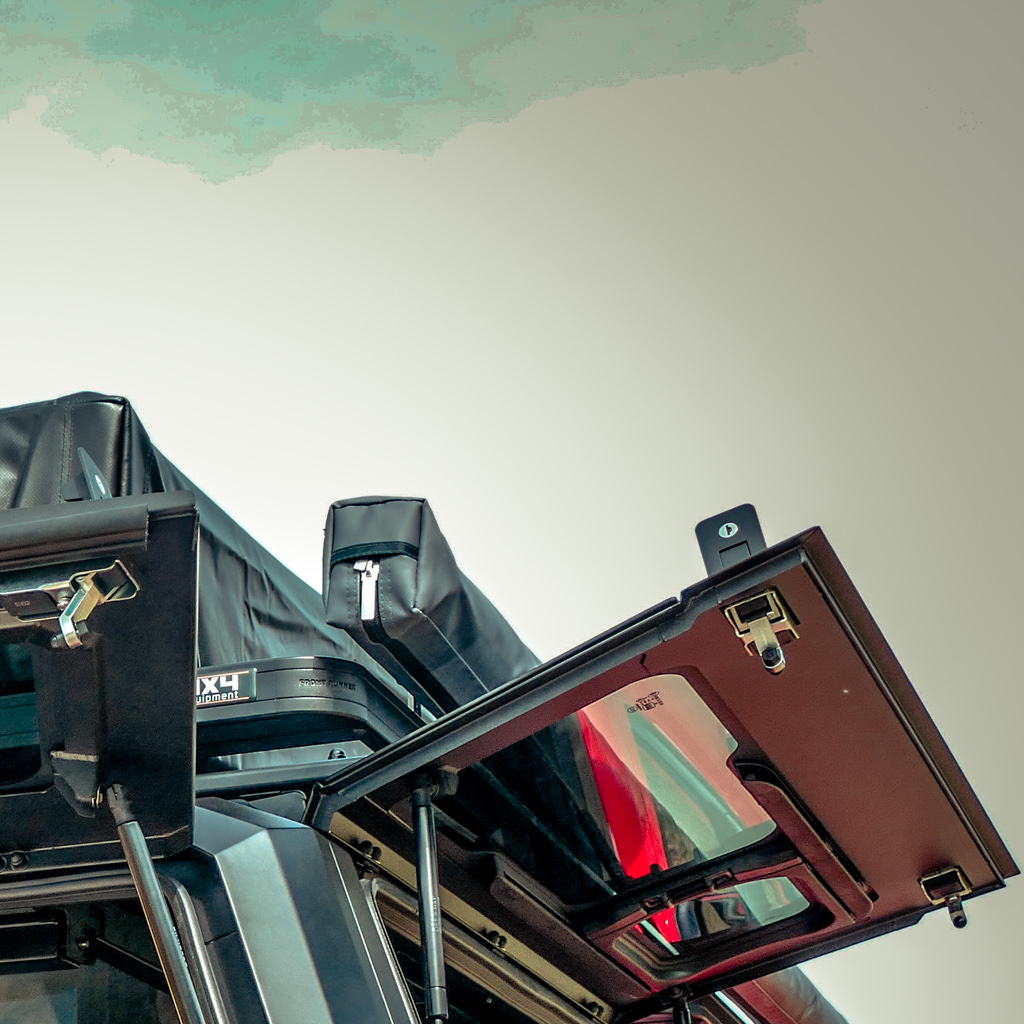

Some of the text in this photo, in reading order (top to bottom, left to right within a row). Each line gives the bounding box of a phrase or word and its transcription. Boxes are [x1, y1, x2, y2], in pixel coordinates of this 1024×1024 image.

[298, 678, 356, 691] FRONT RUNNER
[196, 691, 239, 704] uipment
